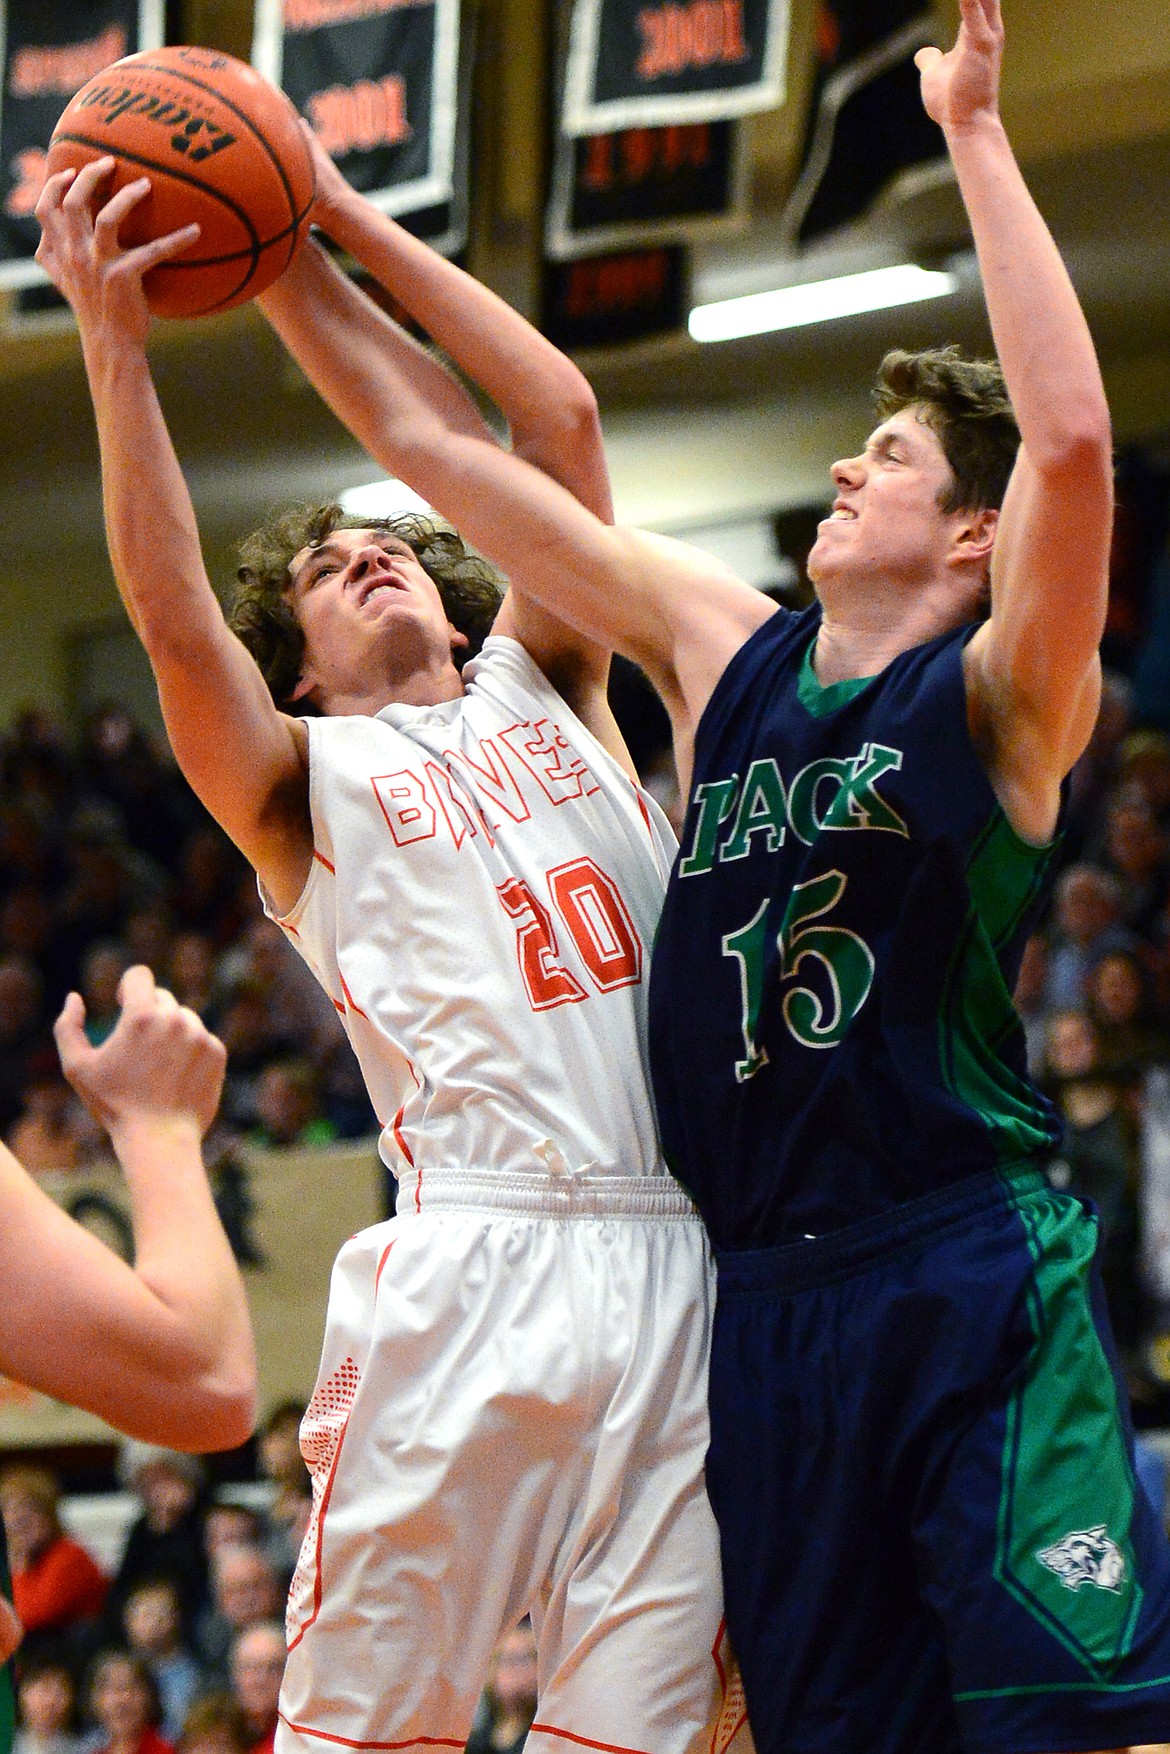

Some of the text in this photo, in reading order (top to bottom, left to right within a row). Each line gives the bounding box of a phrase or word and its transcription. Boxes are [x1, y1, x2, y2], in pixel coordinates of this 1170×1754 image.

[679, 742, 911, 879] PACK
[496, 856, 643, 1013] 20
[721, 869, 876, 1084] 15
